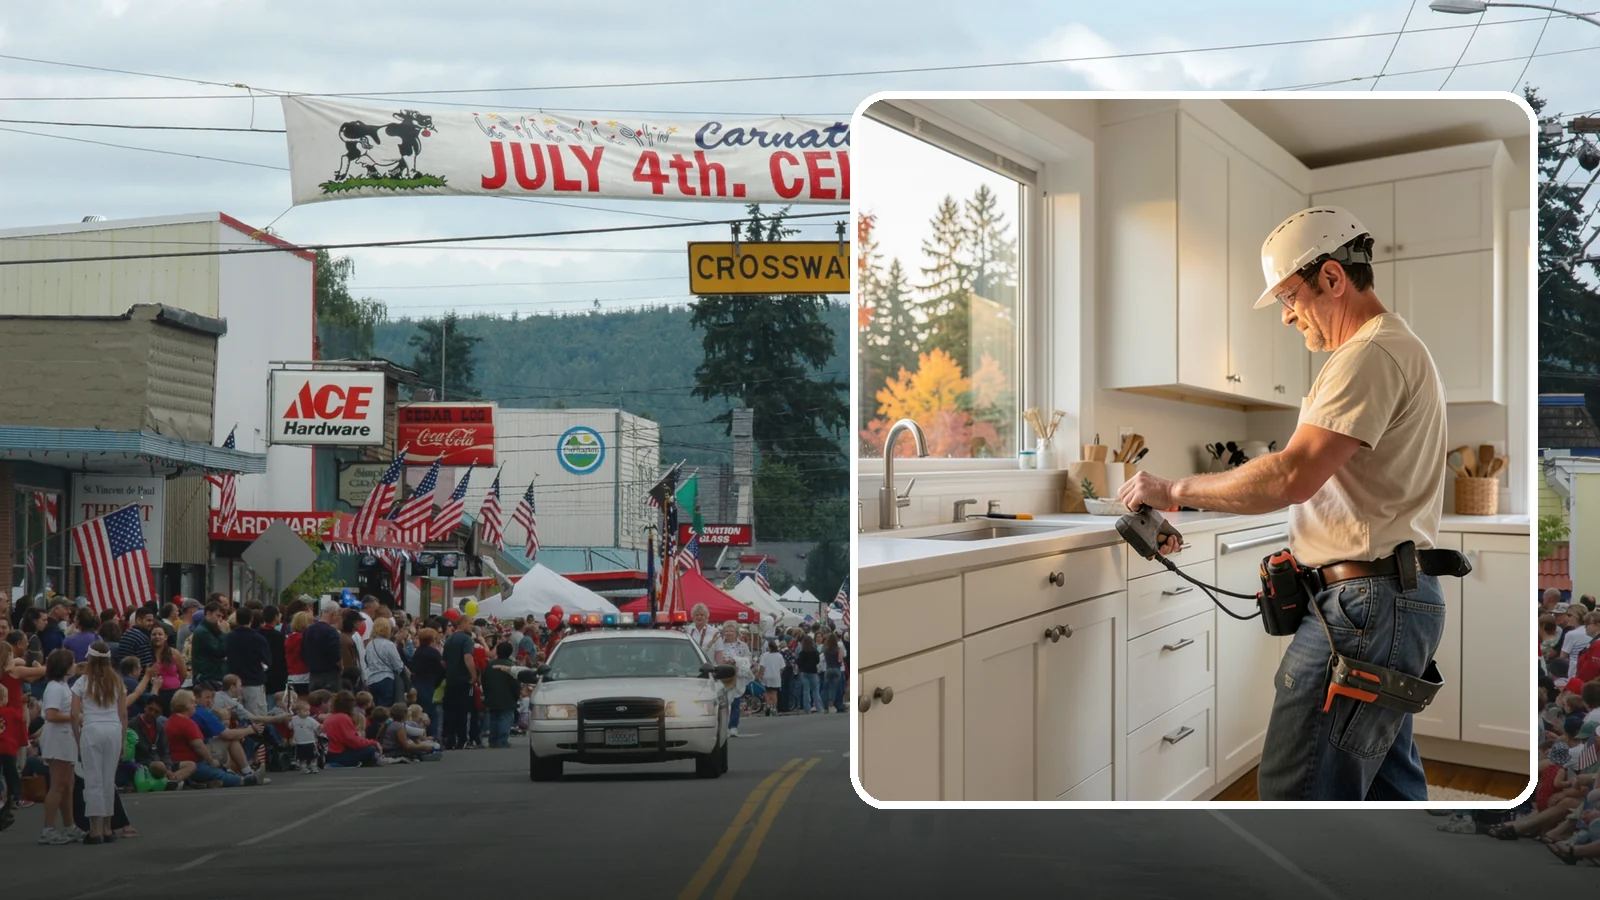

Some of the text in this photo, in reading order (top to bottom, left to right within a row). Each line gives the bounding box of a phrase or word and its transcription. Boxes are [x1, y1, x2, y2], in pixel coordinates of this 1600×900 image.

[481, 141, 604, 192] JULY
[632, 150, 746, 198] 4th.
[697, 253, 850, 280] CROSSWA
[283, 380, 373, 420] ACE
[406, 409, 452, 422] CEDAR
[283, 421, 371, 437] Hardware
[416, 428, 477, 447] Coca-Cola
[353, 467, 384, 480] Simpl
[83, 485, 155, 495] St. Vincent de Paul
[81, 503, 154, 522] THRT
[688, 526, 741, 535] CRNATION
[699, 535, 730, 543] GLASS
